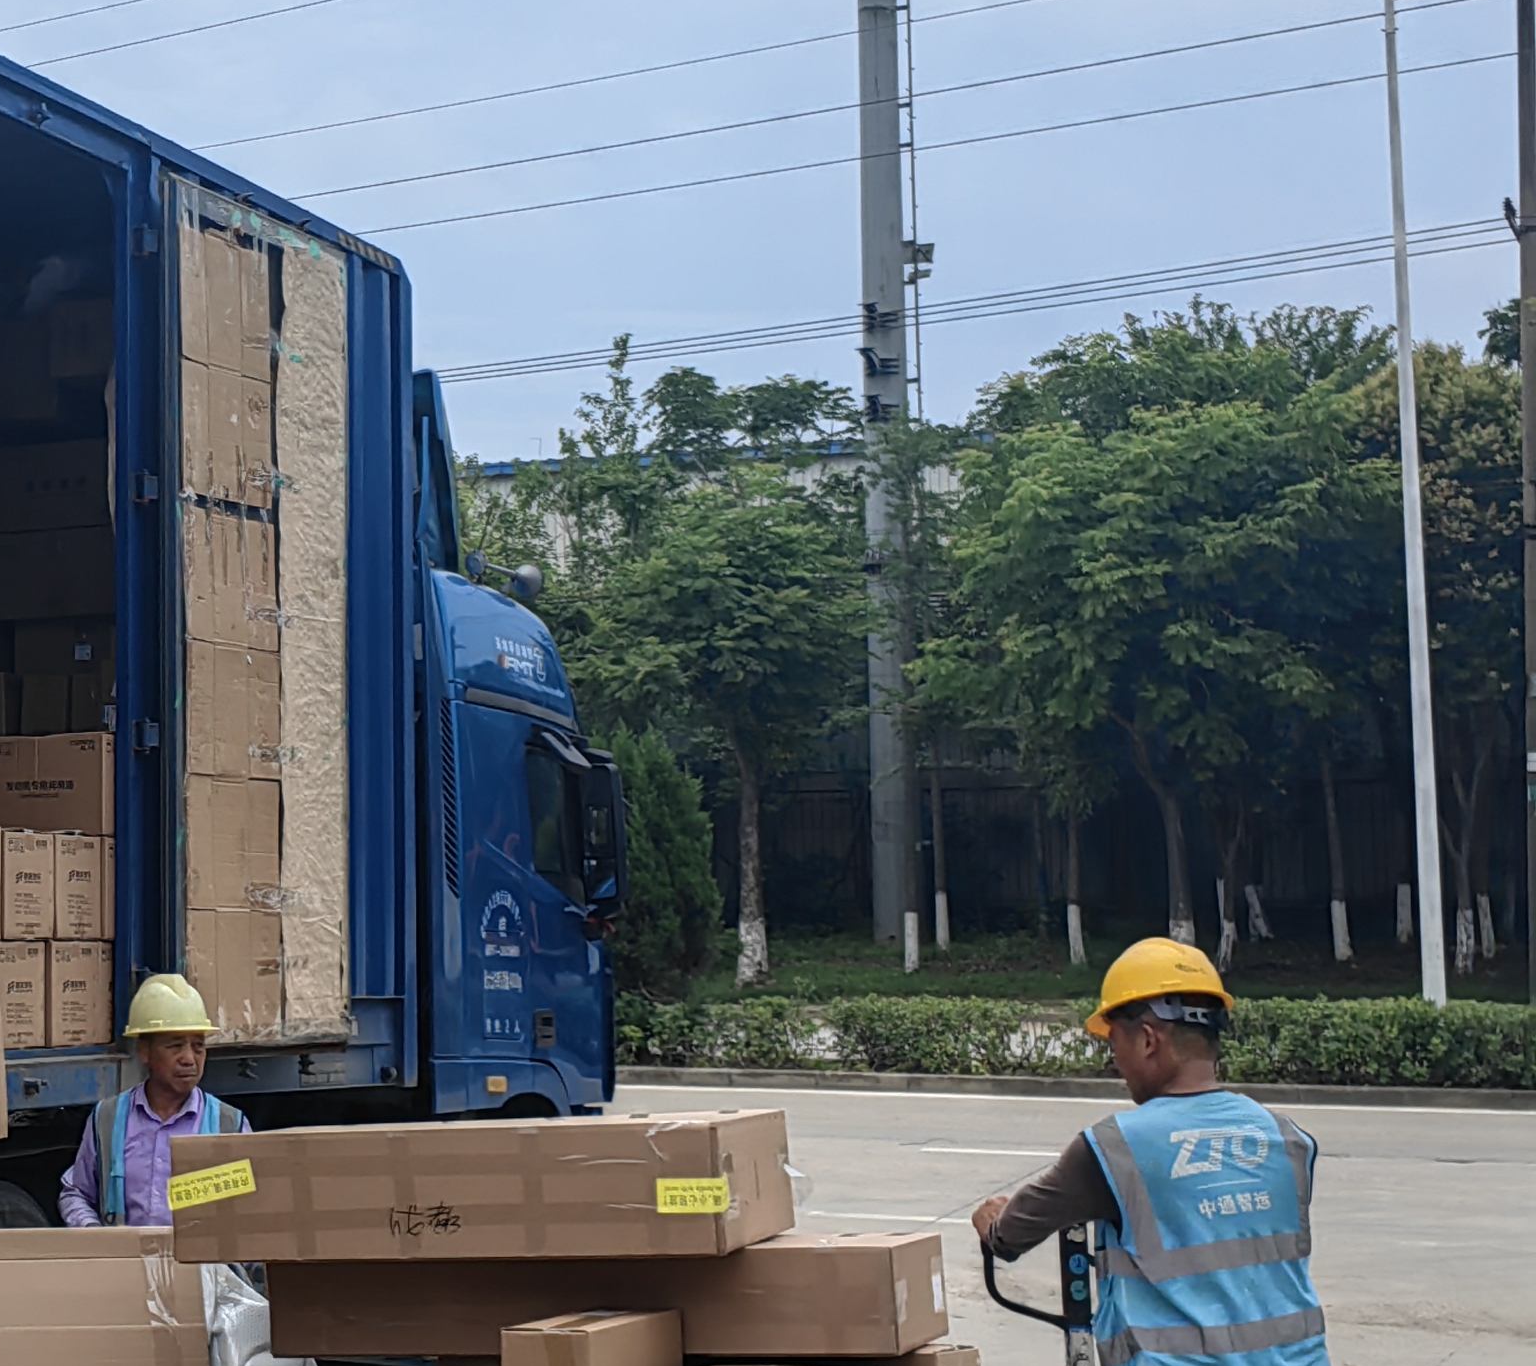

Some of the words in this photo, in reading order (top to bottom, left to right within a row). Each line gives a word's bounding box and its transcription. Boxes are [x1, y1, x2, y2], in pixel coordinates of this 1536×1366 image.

[1170, 1125, 1268, 1179] ZTO
[1199, 1191, 1272, 1219] 中通智运
